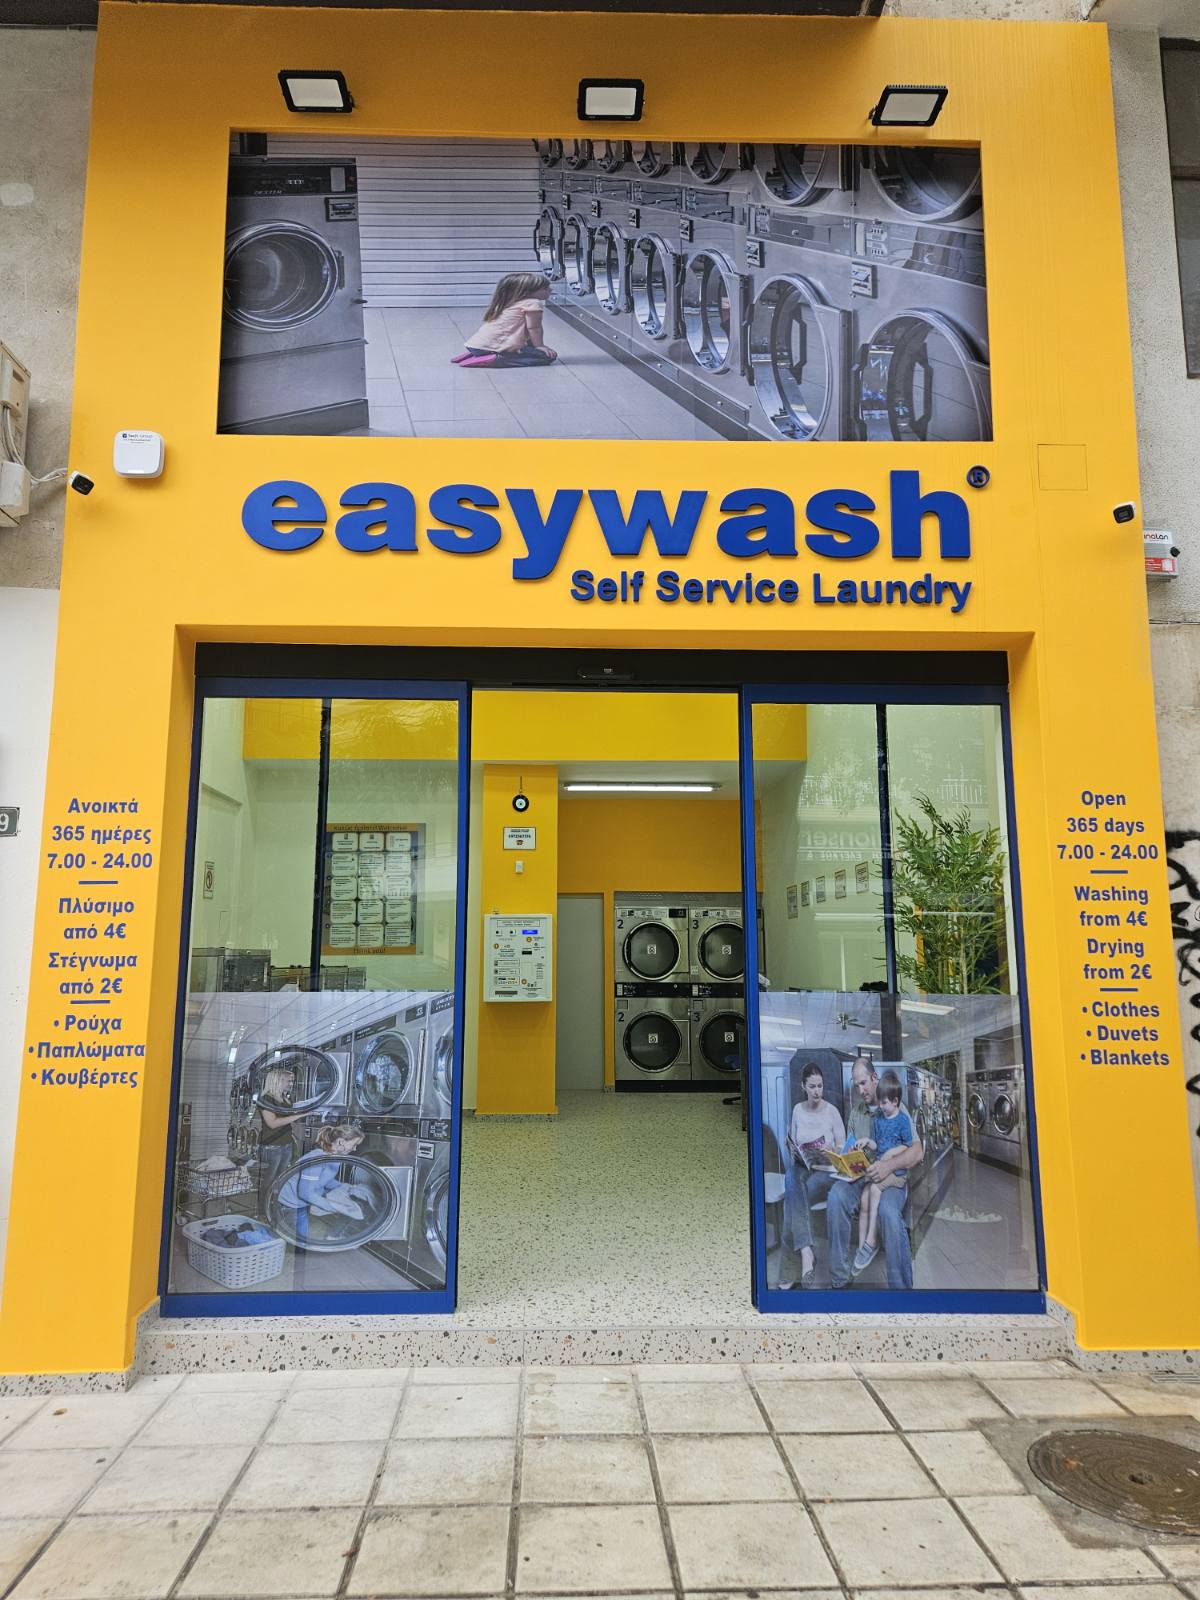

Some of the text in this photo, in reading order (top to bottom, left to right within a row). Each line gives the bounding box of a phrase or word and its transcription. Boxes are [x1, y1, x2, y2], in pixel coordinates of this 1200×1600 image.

[242, 470, 970, 581] easywash
[570, 569, 973, 612] Self Service Laundry
[68, 798, 139, 813] Ανοικτά
[1081, 790, 1126, 808] Open
[53, 825, 151, 844] 365 ημέρες
[1068, 817, 1144, 835] 365 days
[47, 852, 85, 868] 7.00
[103, 852, 153, 868] 24.00
[1057, 844, 1094, 859] 7.00
[1111, 844, 1158, 859] 24.00
[1074, 886, 1149, 904] Washing
[58, 897, 135, 915] Πλύσιμο
[617, 920, 624, 929] 2
[692, 920, 700, 929] 3
[1079, 911, 1147, 926] from 4€
[63, 922, 126, 939] από 4€
[1087, 938, 1145, 957] Drying
[48, 951, 137, 970] Στέγνωμα
[1083, 963, 1152, 979] from 2€
[59, 977, 123, 994] από 2€
[618, 1012, 624, 1022] 2
[1091, 1001, 1159, 1016] Clothes
[64, 1014, 122, 1034] Ρούχα
[1097, 1024, 1158, 1040] Duvets
[37, 1041, 145, 1060] Παπλώματα
[1090, 1049, 1169, 1065] Blankets
[41, 1067, 138, 1088] Κουβέρτες
